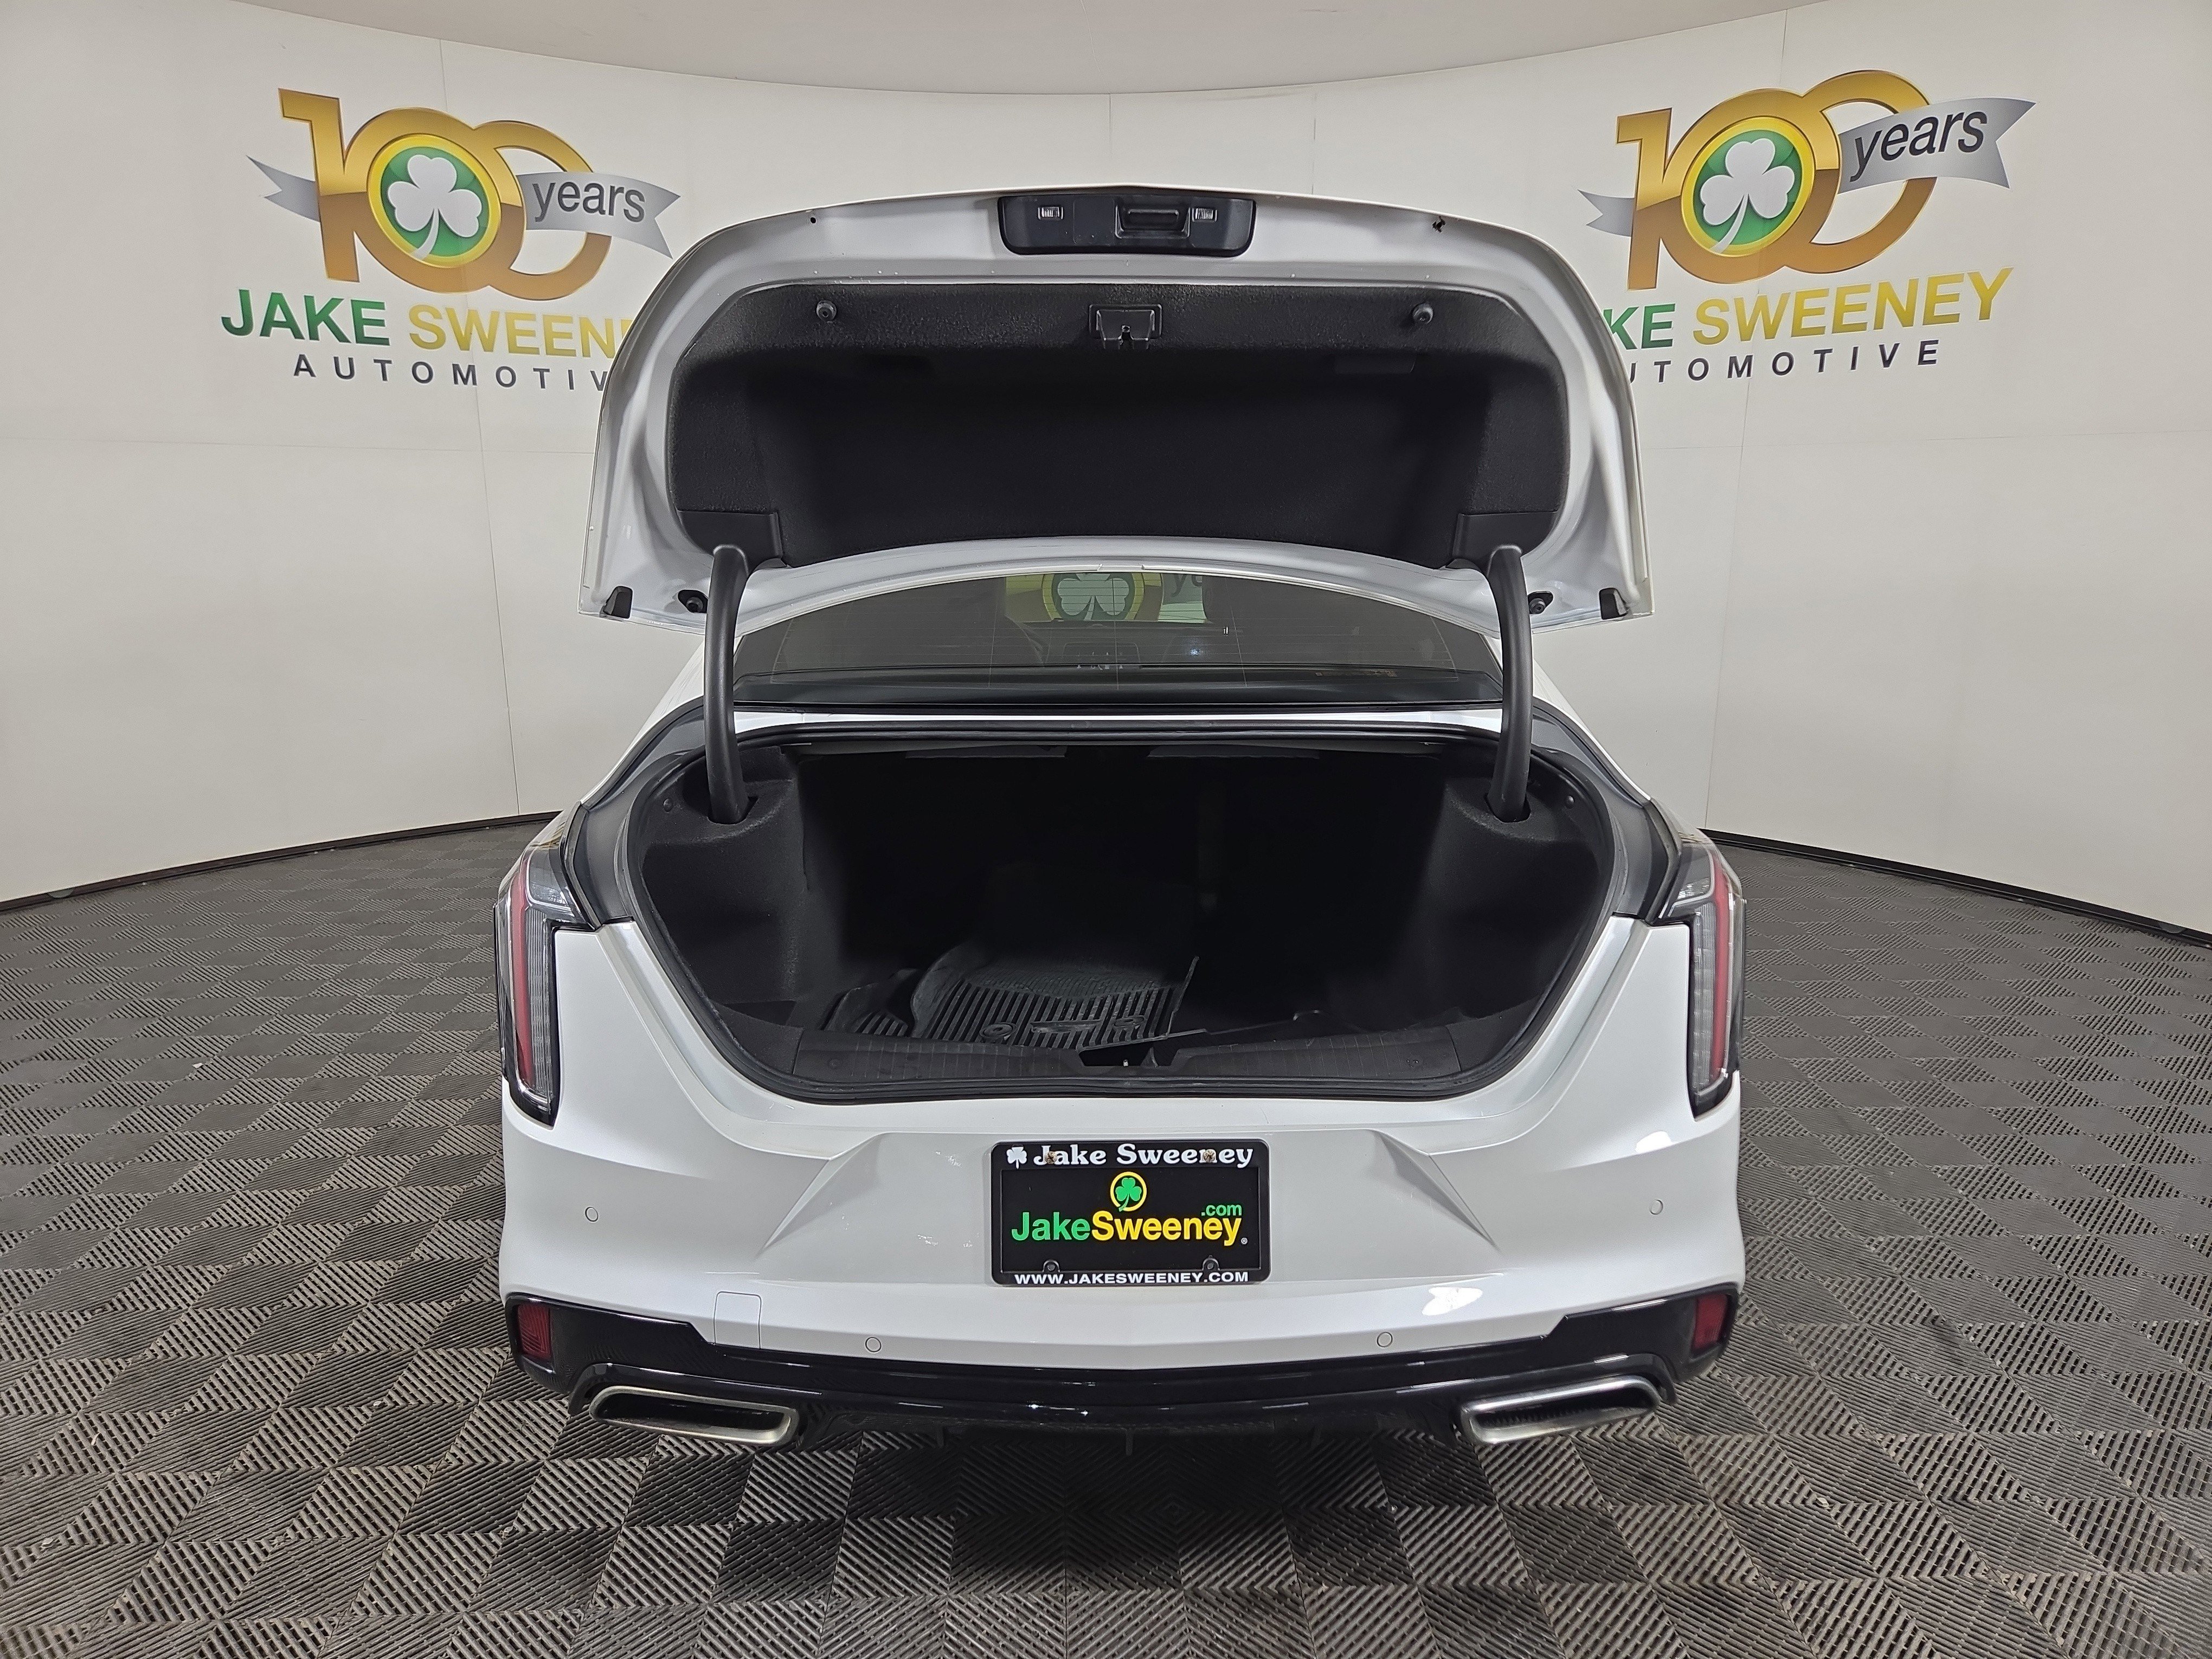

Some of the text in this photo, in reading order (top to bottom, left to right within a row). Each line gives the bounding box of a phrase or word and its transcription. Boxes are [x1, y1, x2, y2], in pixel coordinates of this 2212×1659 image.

[1849, 111, 1988, 183] years
[532, 180, 646, 223] years
[221, 288, 633, 359] JAKE SWEEN
[1603, 266, 2015, 350] KE SWEENEY
[293, 353, 608, 391] AUTOMOTIV
[1630, 339, 1940, 383] TOMOTIVE
[1033, 1143, 1253, 1168] Jake Sweeney
[1201, 1203, 1242, 1217] .com
[1014, 1271, 1249, 1285] WWW.JAKESWEENEY.COM
